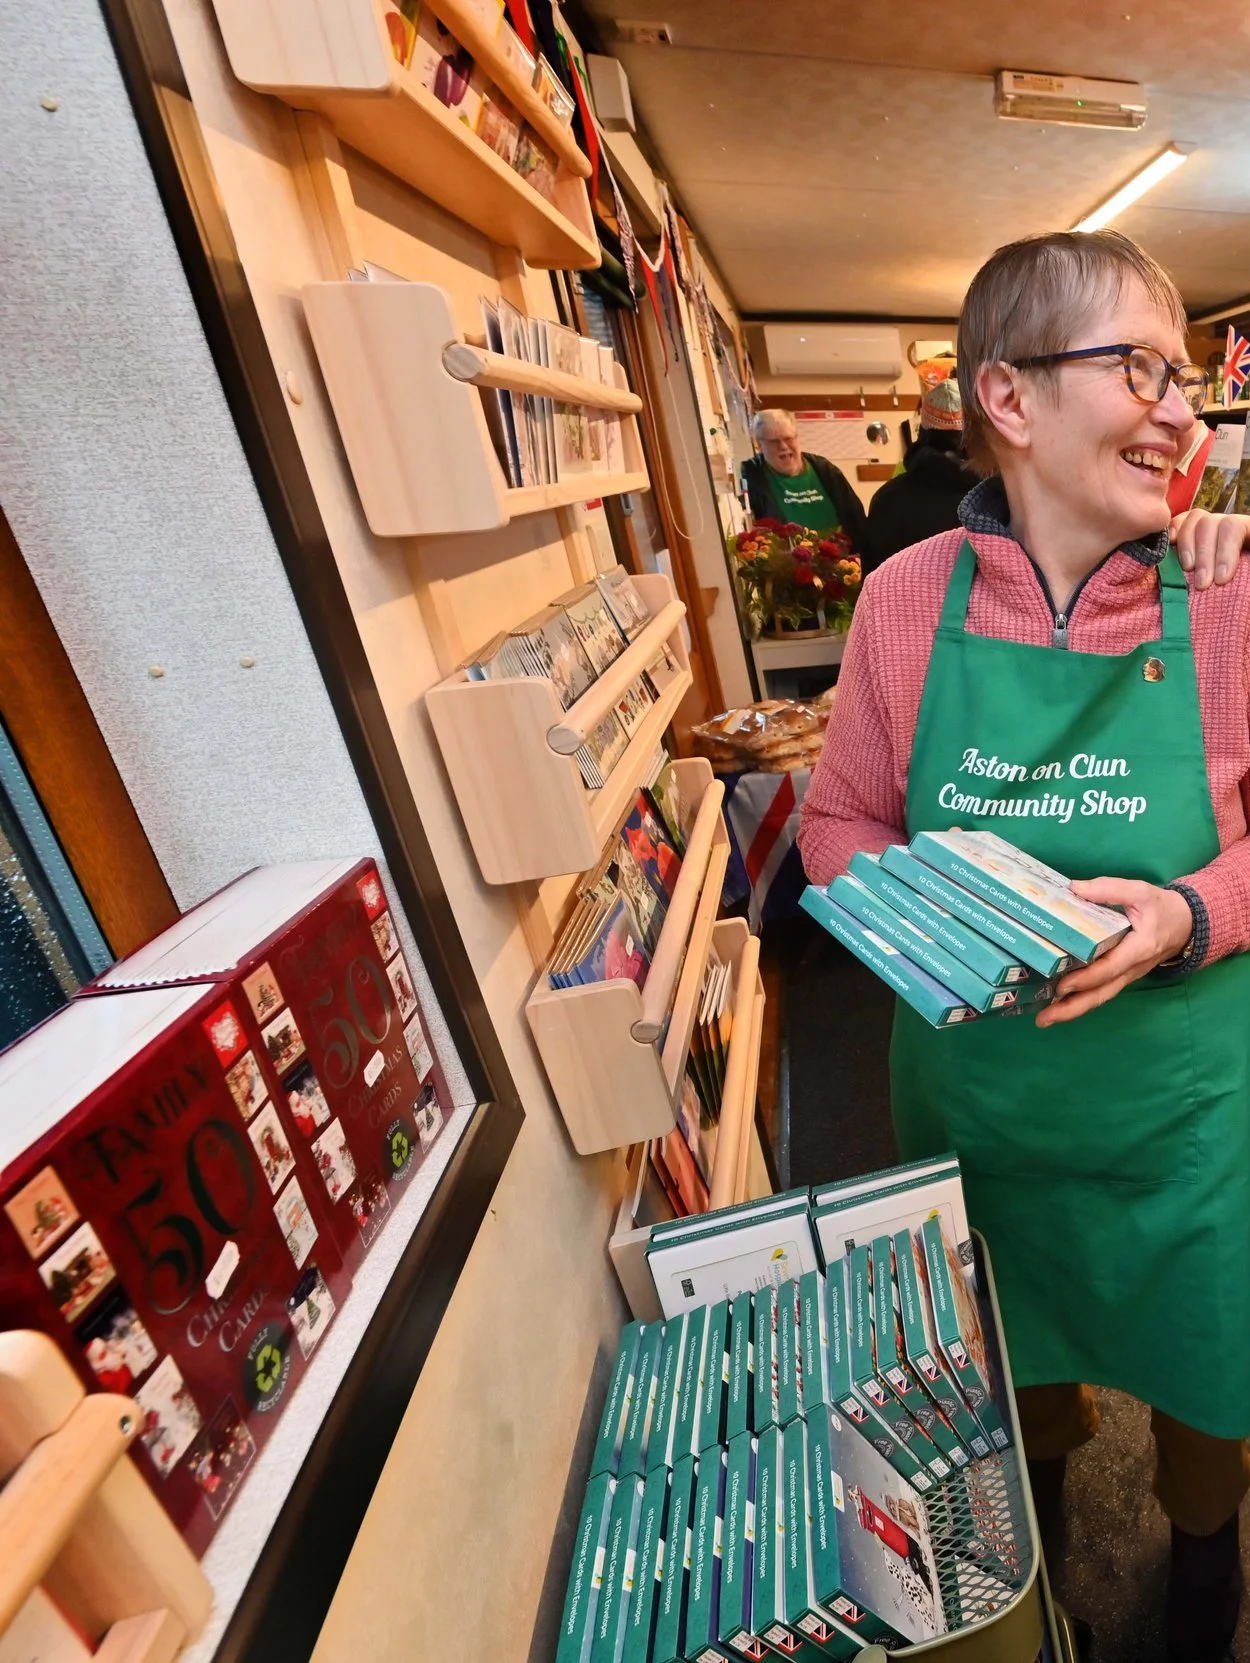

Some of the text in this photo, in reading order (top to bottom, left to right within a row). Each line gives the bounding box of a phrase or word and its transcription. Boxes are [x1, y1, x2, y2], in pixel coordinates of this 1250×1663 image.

[958, 748, 1131, 782] Aston on Clun
[938, 783, 1147, 823] Community Shop
[917, 875, 1017, 944] 10 Christmas Cards with Envelopes
[957, 866, 989, 890] Christmas
[988, 886, 1007, 901] Cards
[1006, 898, 1022, 910] with
[1021, 907, 1054, 931] Envelopes
[880, 882, 966, 951] 10 Christmas Cards with Envelopes
[828, 918, 910, 991] 10 Christmas Cards with Envelopes
[861, 906, 952, 977] 10 Christmas Cards with Envelopes
[309, 955, 391, 1089] 50
[368, 1084, 402, 1129] CARDS
[123, 1117, 254, 1316] 50
[815, 1452, 823, 1483] Christmas
[671, 1506, 680, 1540] Christmas
[700, 1495, 708, 1528] Christmas
[580, 1523, 592, 1559] Christmas
[610, 1526, 621, 1562] Christmas
[643, 1516, 654, 1551] Christmas
[818, 1518, 827, 1550] Envelopes
[641, 1552, 649, 1572] Cards
[669, 1542, 677, 1561] Cards
[726, 1549, 734, 1583] Envelopes
[789, 1536, 797, 1568] Envelopes
[577, 1560, 586, 1580] Cards
[608, 1563, 616, 1583] Cards
[693, 1566, 703, 1600] Envelopes
[574, 1581, 582, 1597] with
[605, 1584, 613, 1601] with
[663, 1579, 673, 1614] Envelopes
[566, 1598, 579, 1635] Envelopes
[599, 1601, 611, 1638] Envelopes
[633, 1590, 644, 1627] Envelopes
